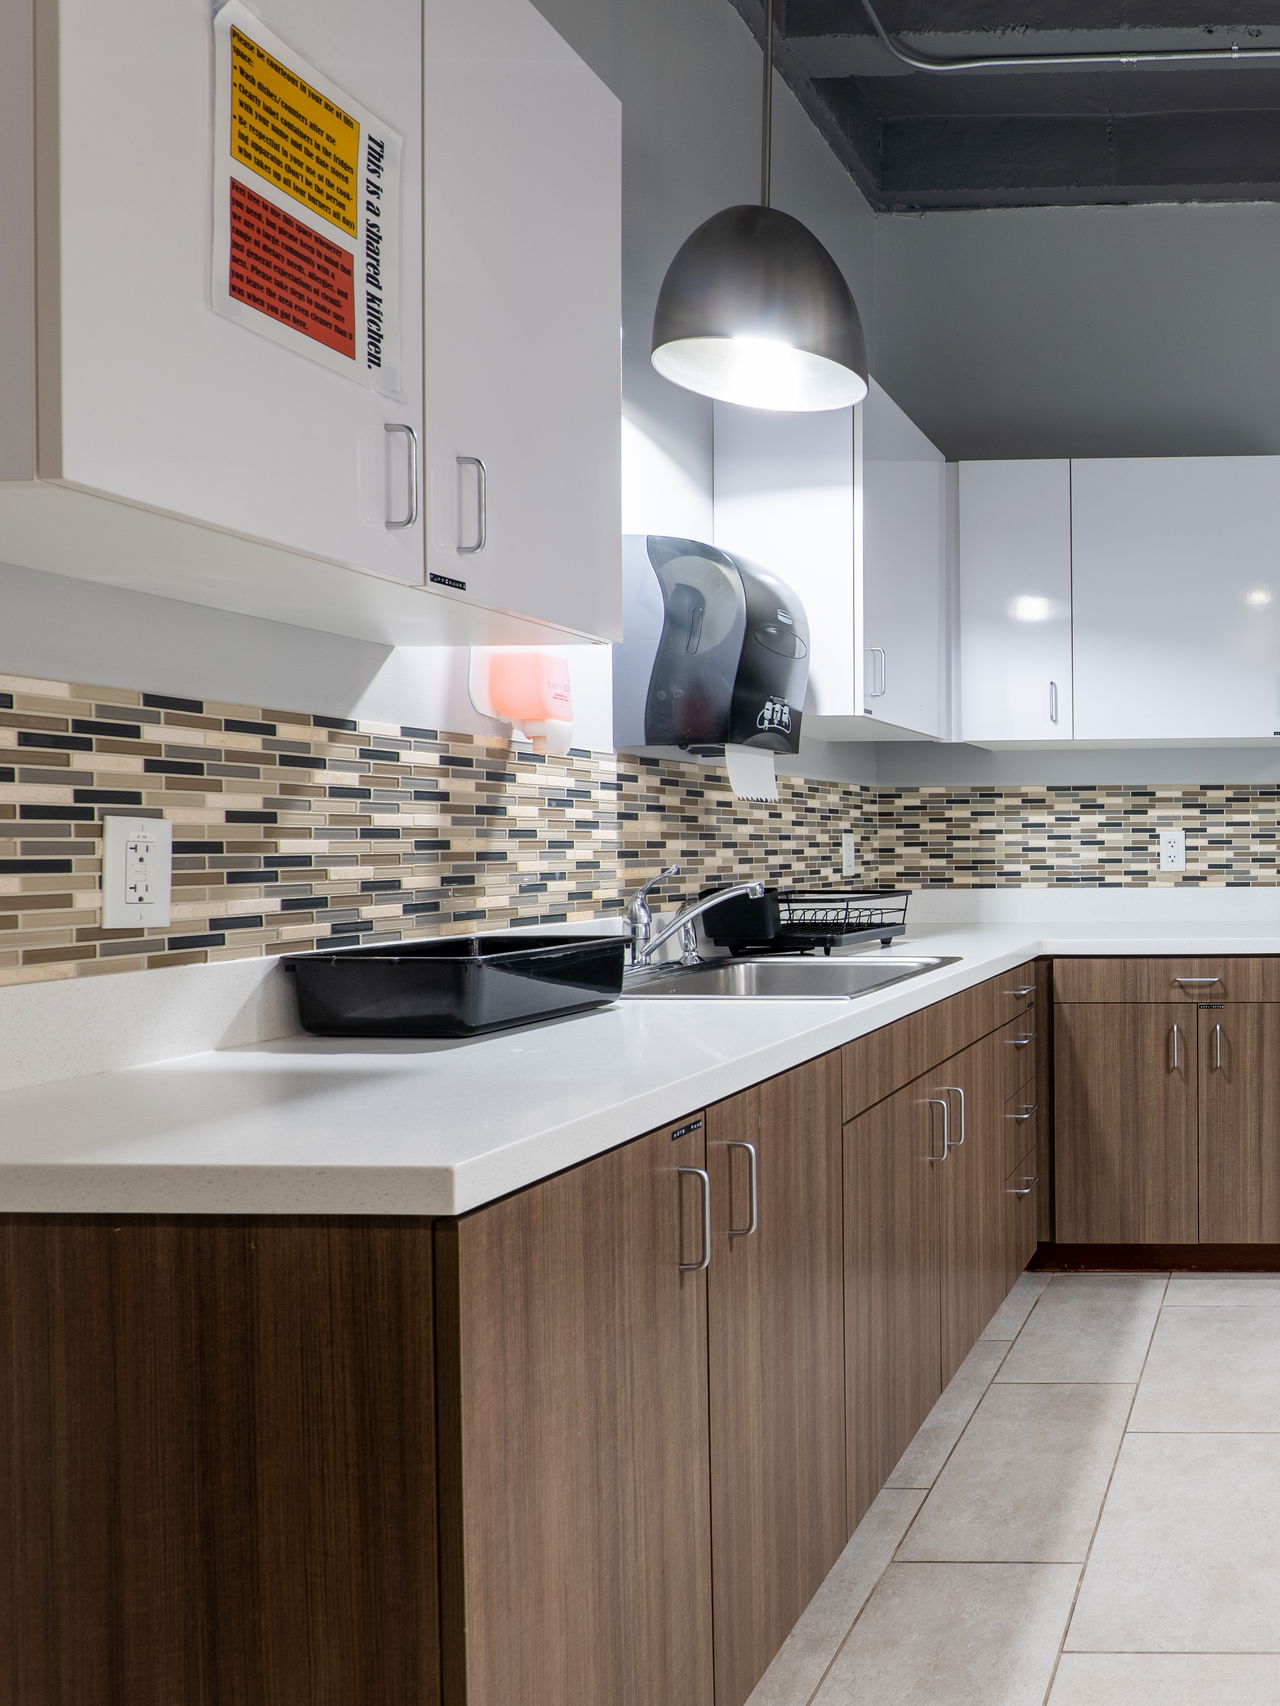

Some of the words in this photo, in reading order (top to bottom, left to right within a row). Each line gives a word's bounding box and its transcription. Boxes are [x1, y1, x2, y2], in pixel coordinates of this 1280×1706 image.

[231, 29, 254, 53] Please
[266, 58, 298, 87] courteous
[307, 89, 322, 105] your
[232, 45, 253, 66] space:
[238, 66, 255, 85] Wash
[308, 121, 324, 136] after
[238, 83, 260, 107] Clearly
[262, 102, 278, 120] label
[280, 116, 312, 145] containers
[333, 154, 353, 174] fridges
[238, 98, 253, 115] with
[254, 111, 269, 127] your
[271, 123, 288, 141] name
[315, 155, 329, 169] date
[330, 166, 348, 184] stored
[248, 124, 280, 152] respectful
[289, 154, 304, 168] your
[250, 140, 283, 168] apparatus
[325, 192, 345, 210] person
[366, 134, 385, 179] This
[238, 145, 252, 160] who
[253, 156, 270, 174] takes
[292, 182, 306, 197] four
[307, 192, 331, 214] burners
[341, 216, 355, 230] day)
[366, 178, 384, 200] is
[366, 200, 381, 217] a
[231, 225, 251, 242] range
[261, 243, 284, 263] dietary
[262, 229, 279, 245] large
[278, 226, 298, 243] please
[299, 238, 314, 254] keep
[323, 254, 338, 268] mind
[295, 223, 312, 239] space
[246, 248, 271, 268] general
[365, 218, 382, 291] shared
[246, 292, 264, 306] when
[246, 276, 264, 291] leave
[310, 313, 332, 329] cleaner
[250, 264, 272, 282] Please
[289, 287, 305, 301] steps
[366, 290, 384, 369] kitchen.
